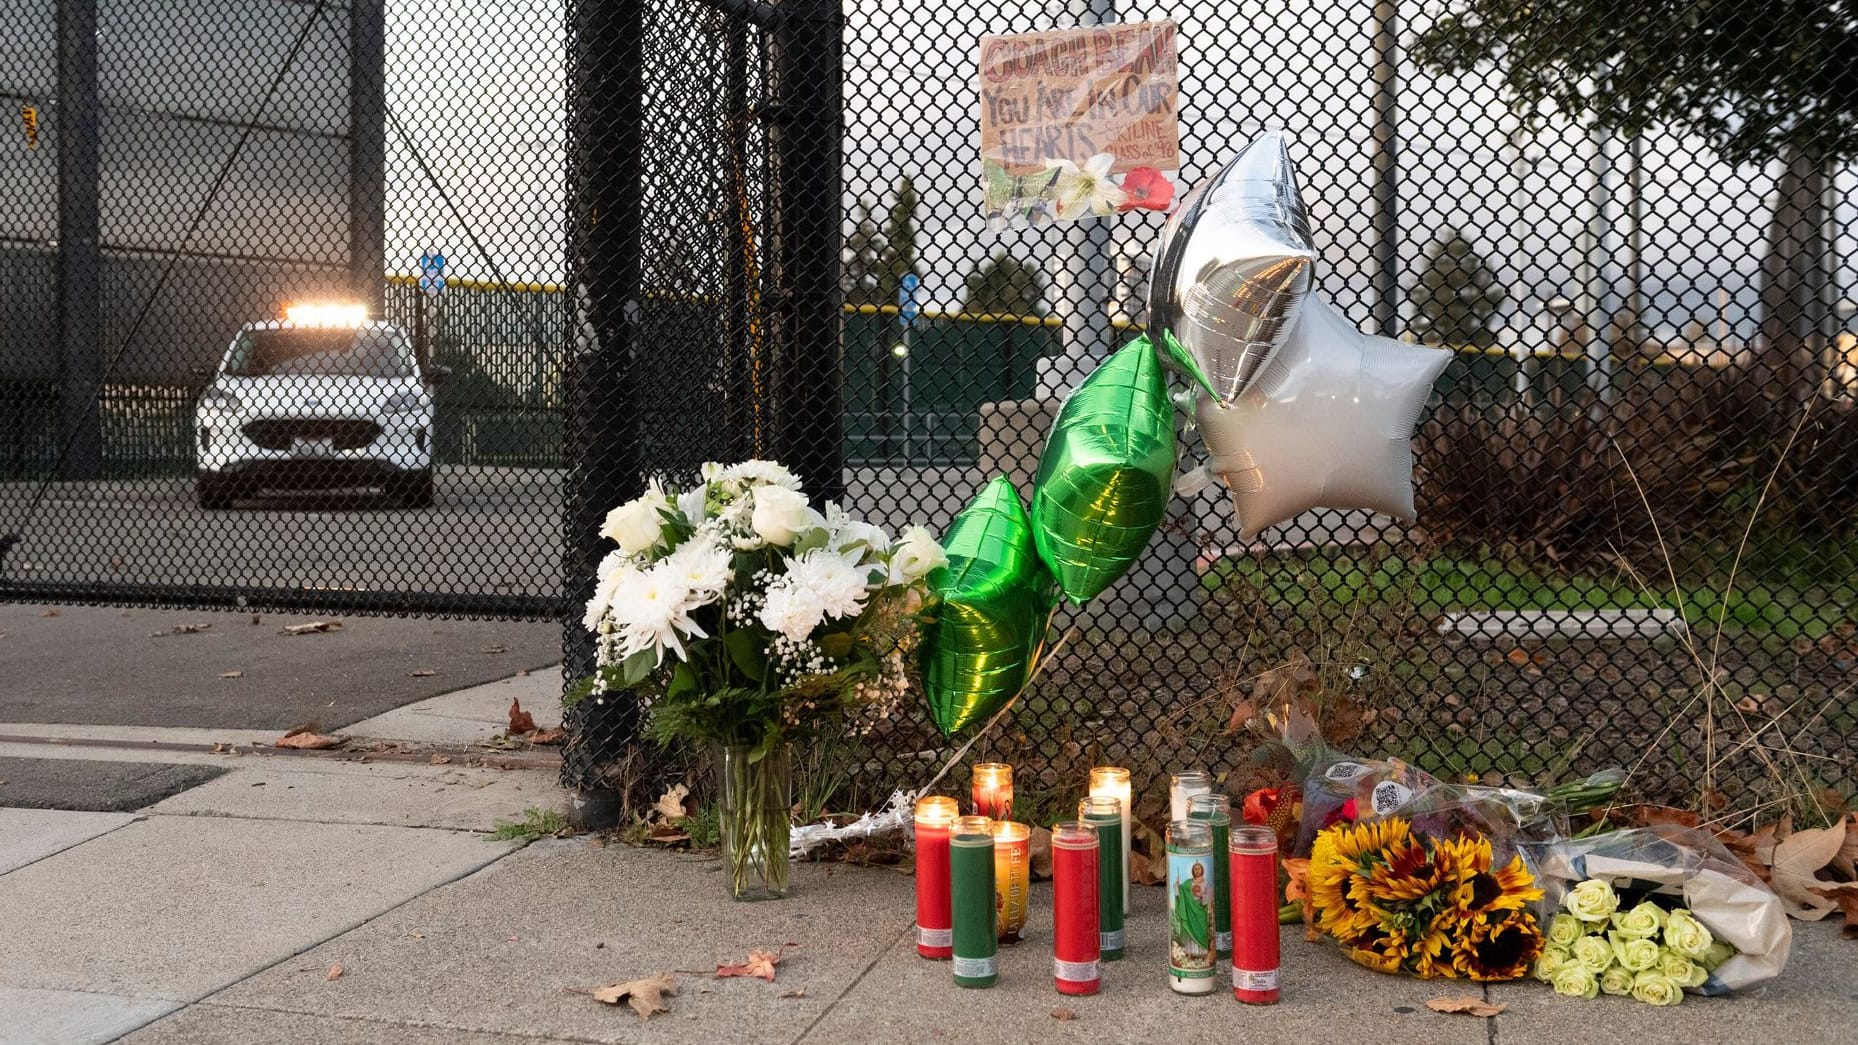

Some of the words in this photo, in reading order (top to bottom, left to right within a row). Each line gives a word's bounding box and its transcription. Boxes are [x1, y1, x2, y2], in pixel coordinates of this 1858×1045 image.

[984, 36, 1088, 83] COACH
[1122, 74, 1173, 116] OUR
[999, 120, 1098, 166] HEARTS
[1105, 119, 1168, 141] SKYLINE
[1104, 143, 1141, 160] CLASS
[1010, 847, 1021, 865] FE
